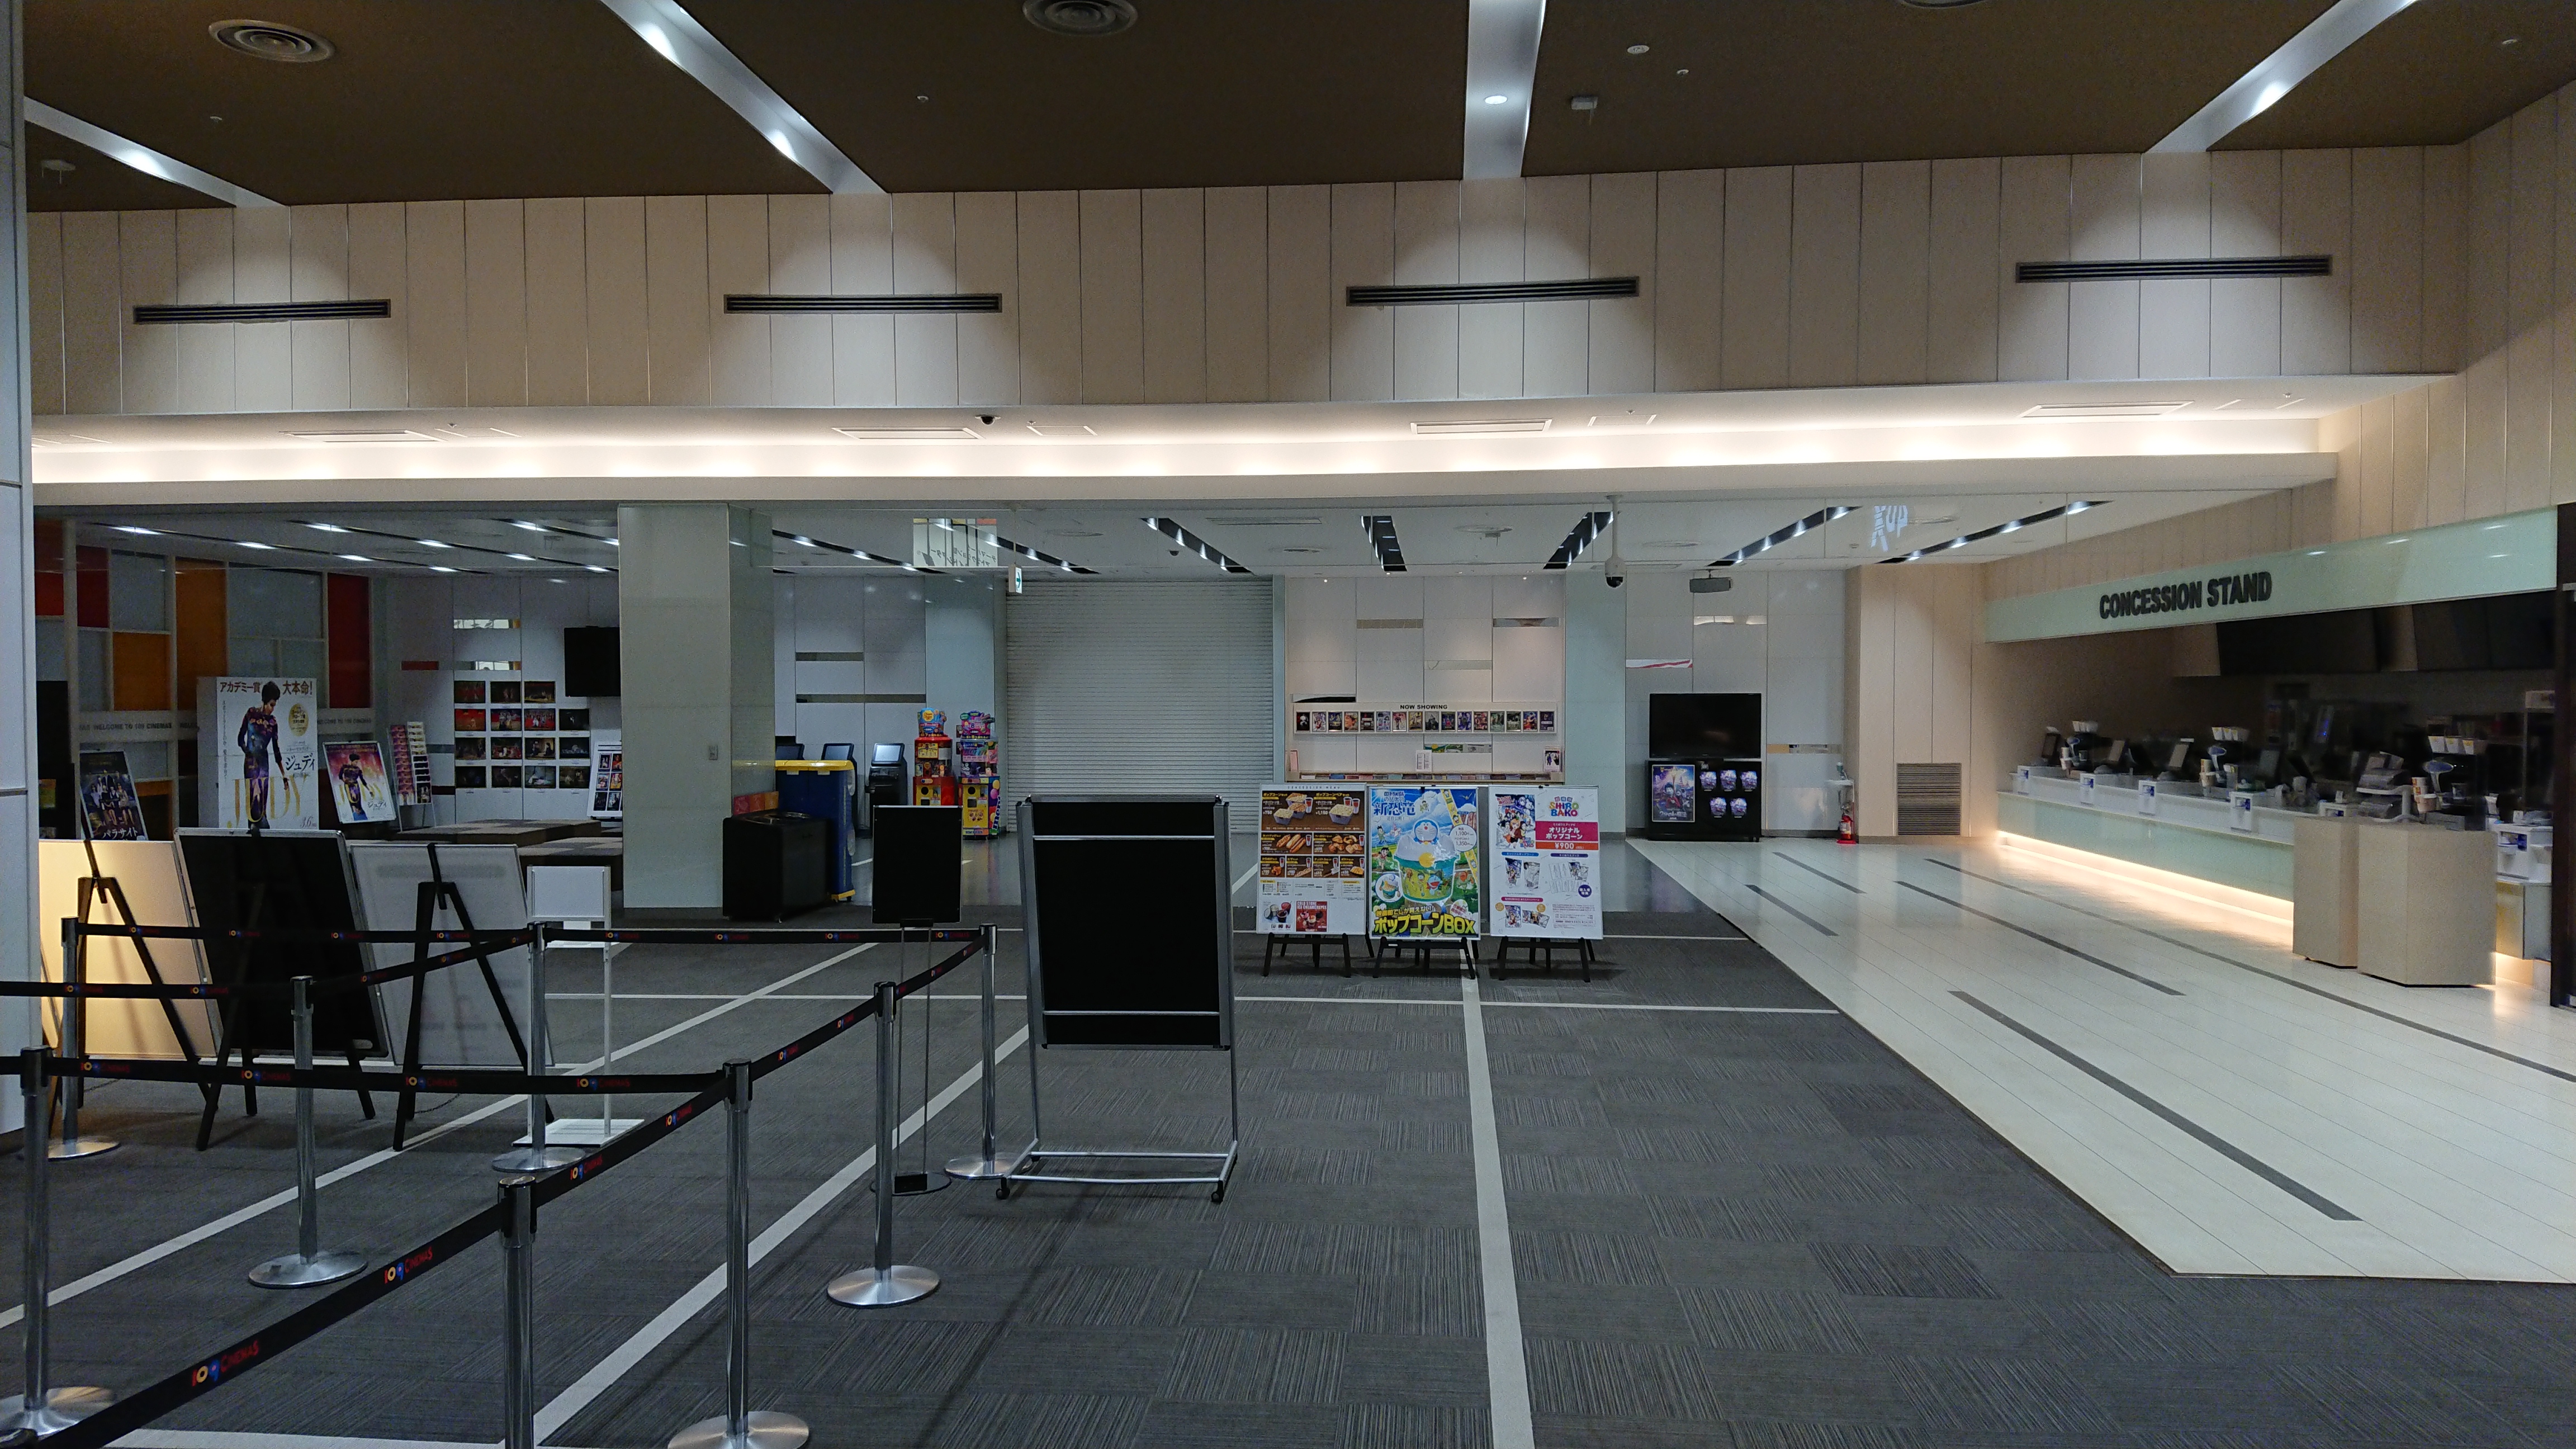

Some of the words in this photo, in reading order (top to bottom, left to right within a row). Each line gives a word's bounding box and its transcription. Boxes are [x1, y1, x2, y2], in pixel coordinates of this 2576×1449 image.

[2100, 581, 2202, 619] CONCESSION
[2207, 571, 2272, 607] STAND
[220, 681, 261, 693] アカデミー賞
[285, 752, 315, 771] ジュディ
[226, 774, 311, 828] JUDY
[1374, 802, 1416, 816] 新恐竜
[1549, 802, 1579, 810] SHIRO
[102, 826, 138, 840] パラサイト
[1375, 912, 1476, 934] ポップコーンBOX
[384, 1262, 404, 1285] 109
[404, 1246, 433, 1273] CINEMAS
[192, 1359, 220, 1387] 109
[220, 1339, 259, 1373] CINEMAS
